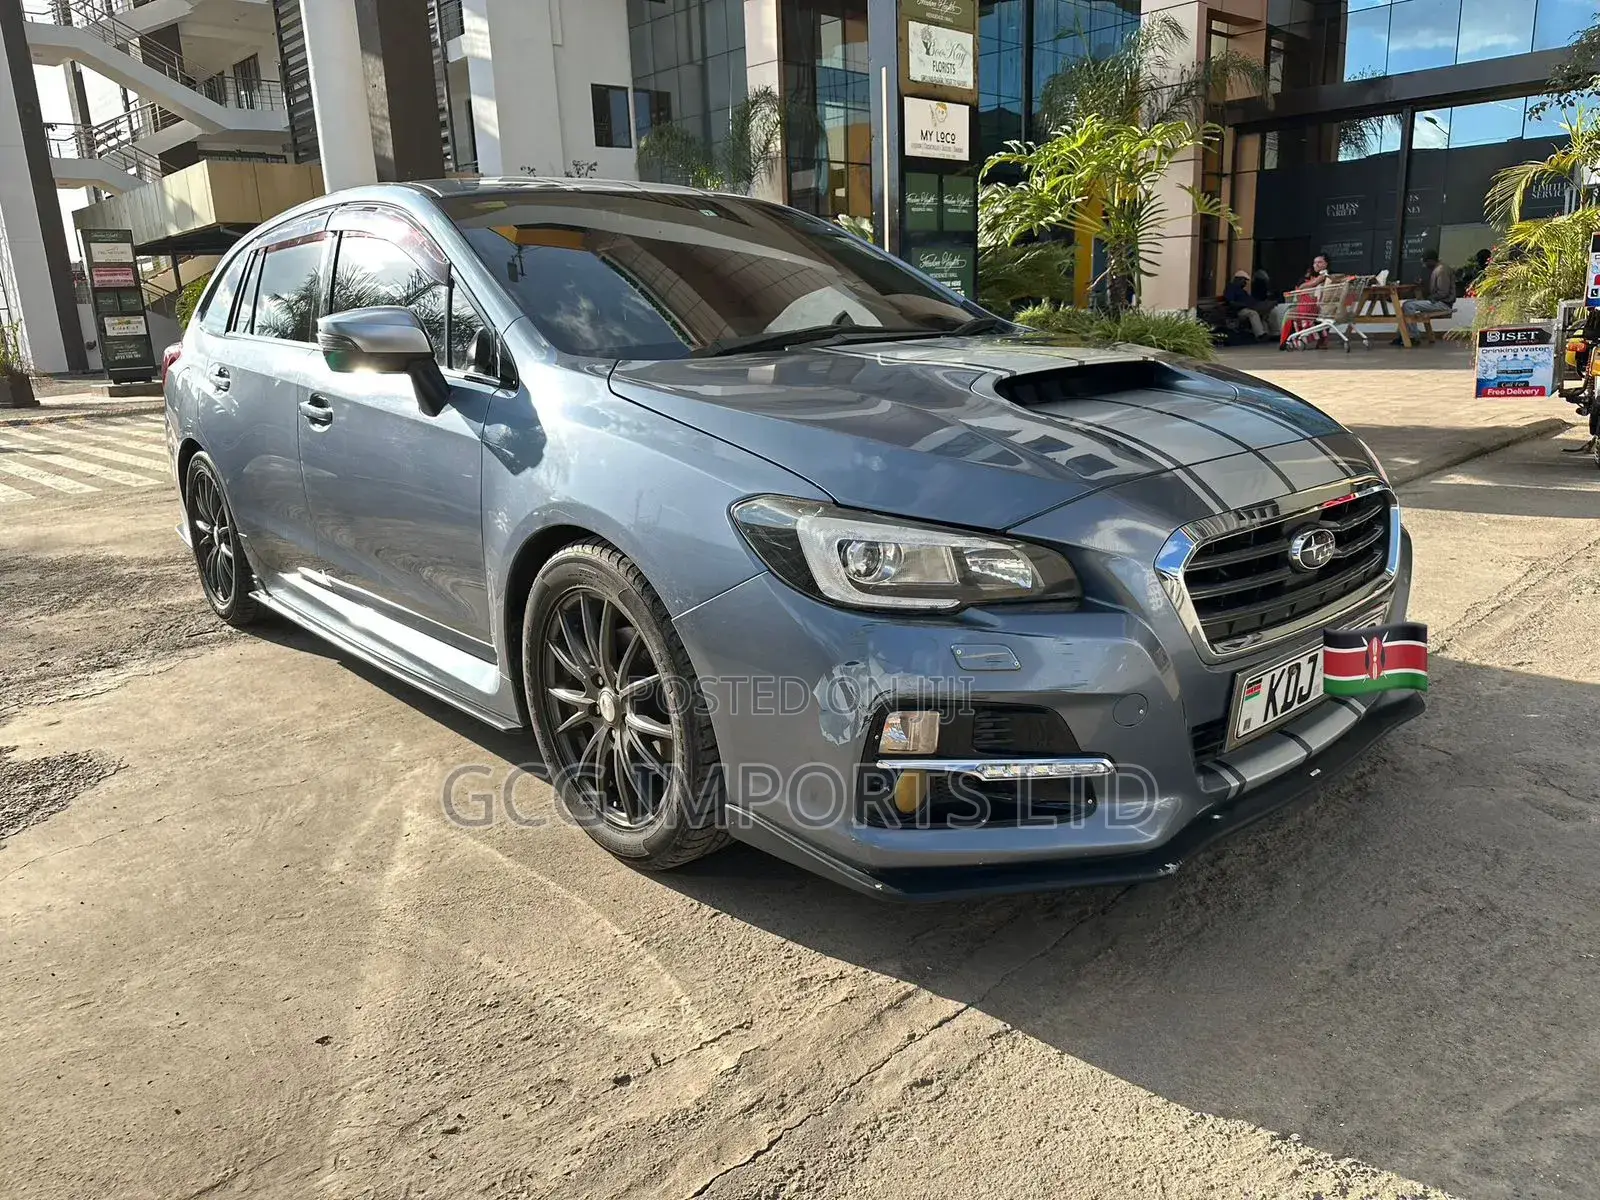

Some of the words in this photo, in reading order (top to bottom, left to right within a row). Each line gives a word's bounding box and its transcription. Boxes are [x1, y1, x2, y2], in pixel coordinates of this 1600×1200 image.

[932, 60, 956, 75] FLORISTS
[920, 130, 933, 141] MY
[1532, 190, 1562, 199] SERVIC
[1486, 331, 1539, 343] BISET
[1481, 346, 1519, 354] Drinking
[1507, 388, 1540, 396] Delivery
[1263, 654, 1319, 723] KDJ
